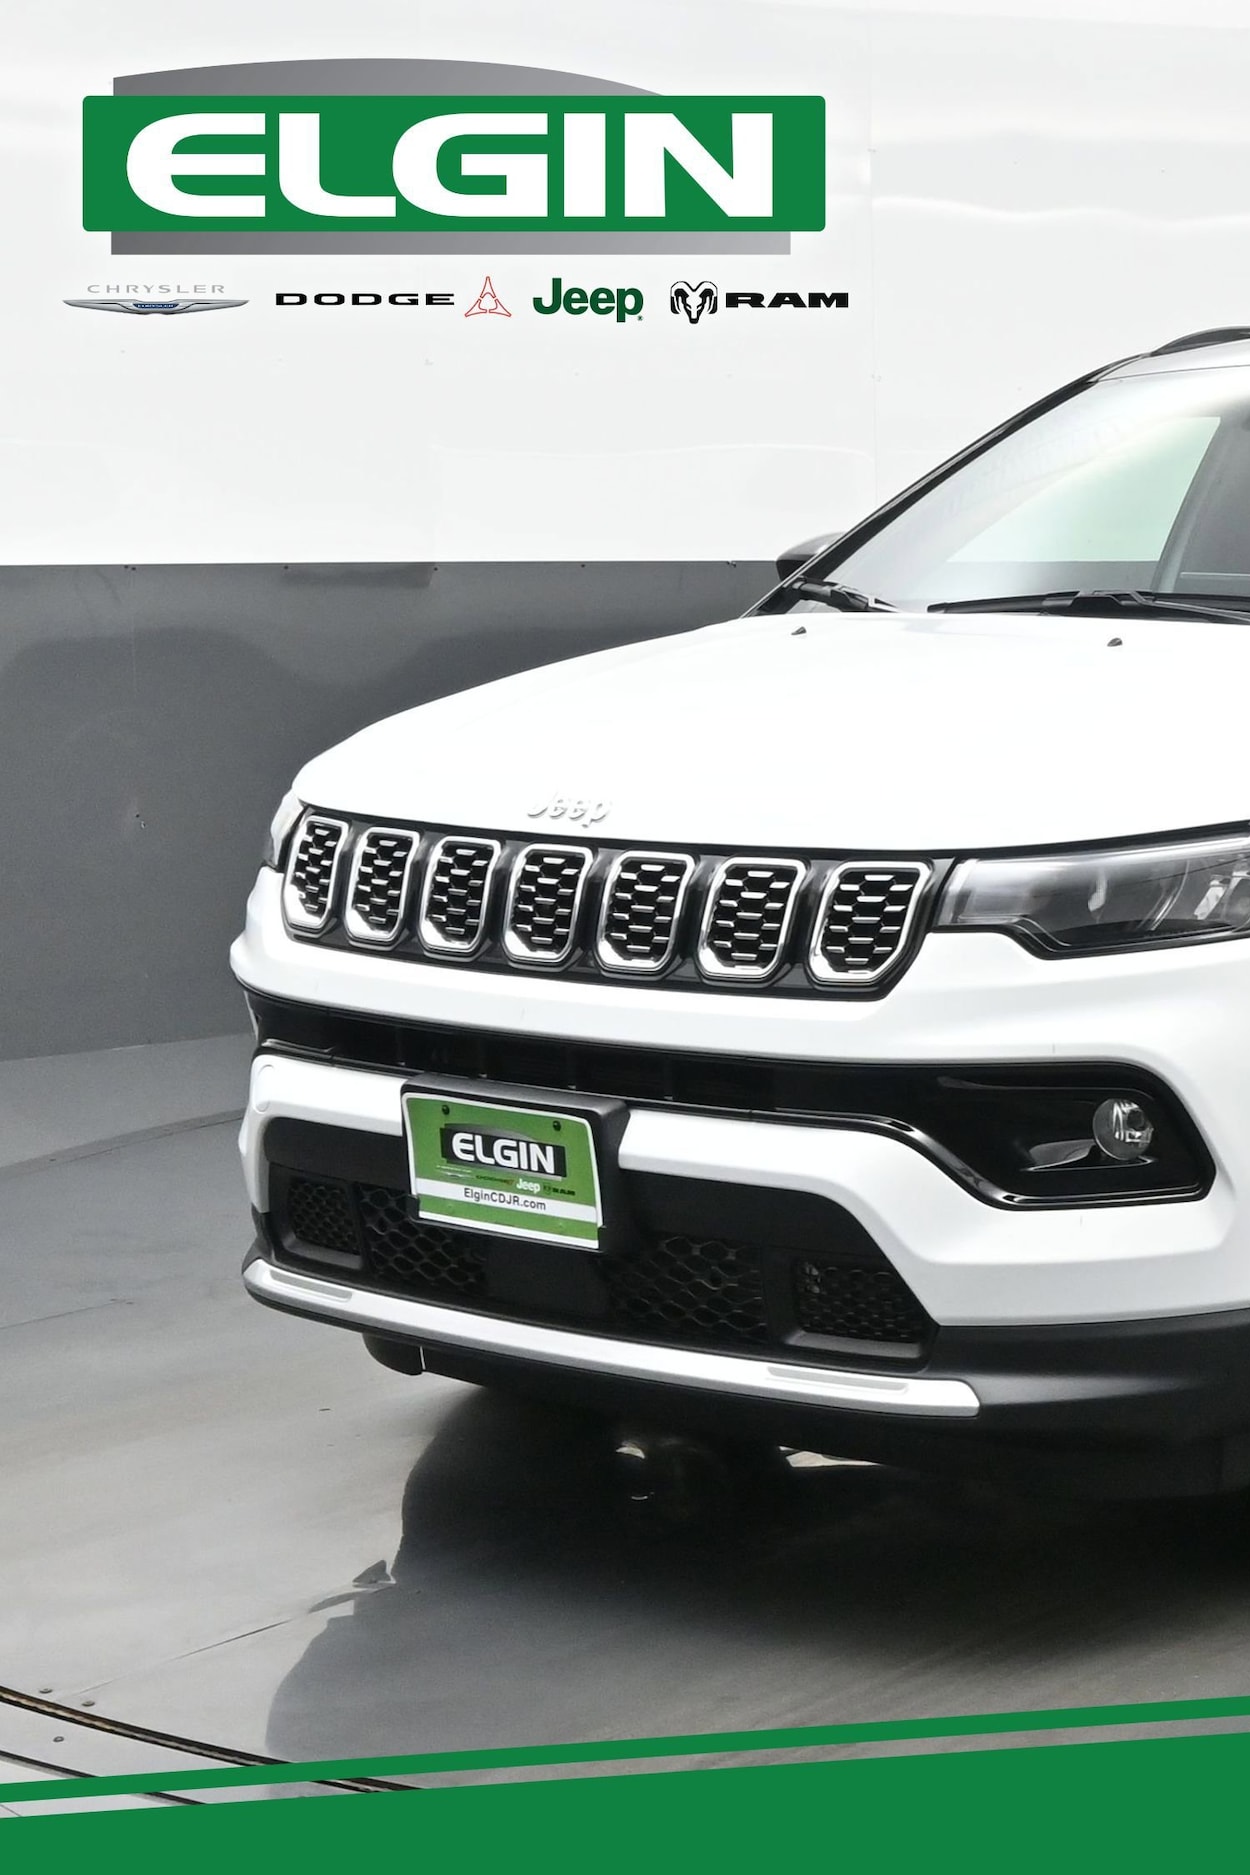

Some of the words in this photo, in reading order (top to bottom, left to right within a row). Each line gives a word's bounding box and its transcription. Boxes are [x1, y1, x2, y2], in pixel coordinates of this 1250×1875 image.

[530, 792, 611, 829] Jeep
[452, 1132, 555, 1174] ELGIN
[463, 1187, 547, 1210] ElginCDJR.com
[516, 1178, 541, 1193] Jeep
